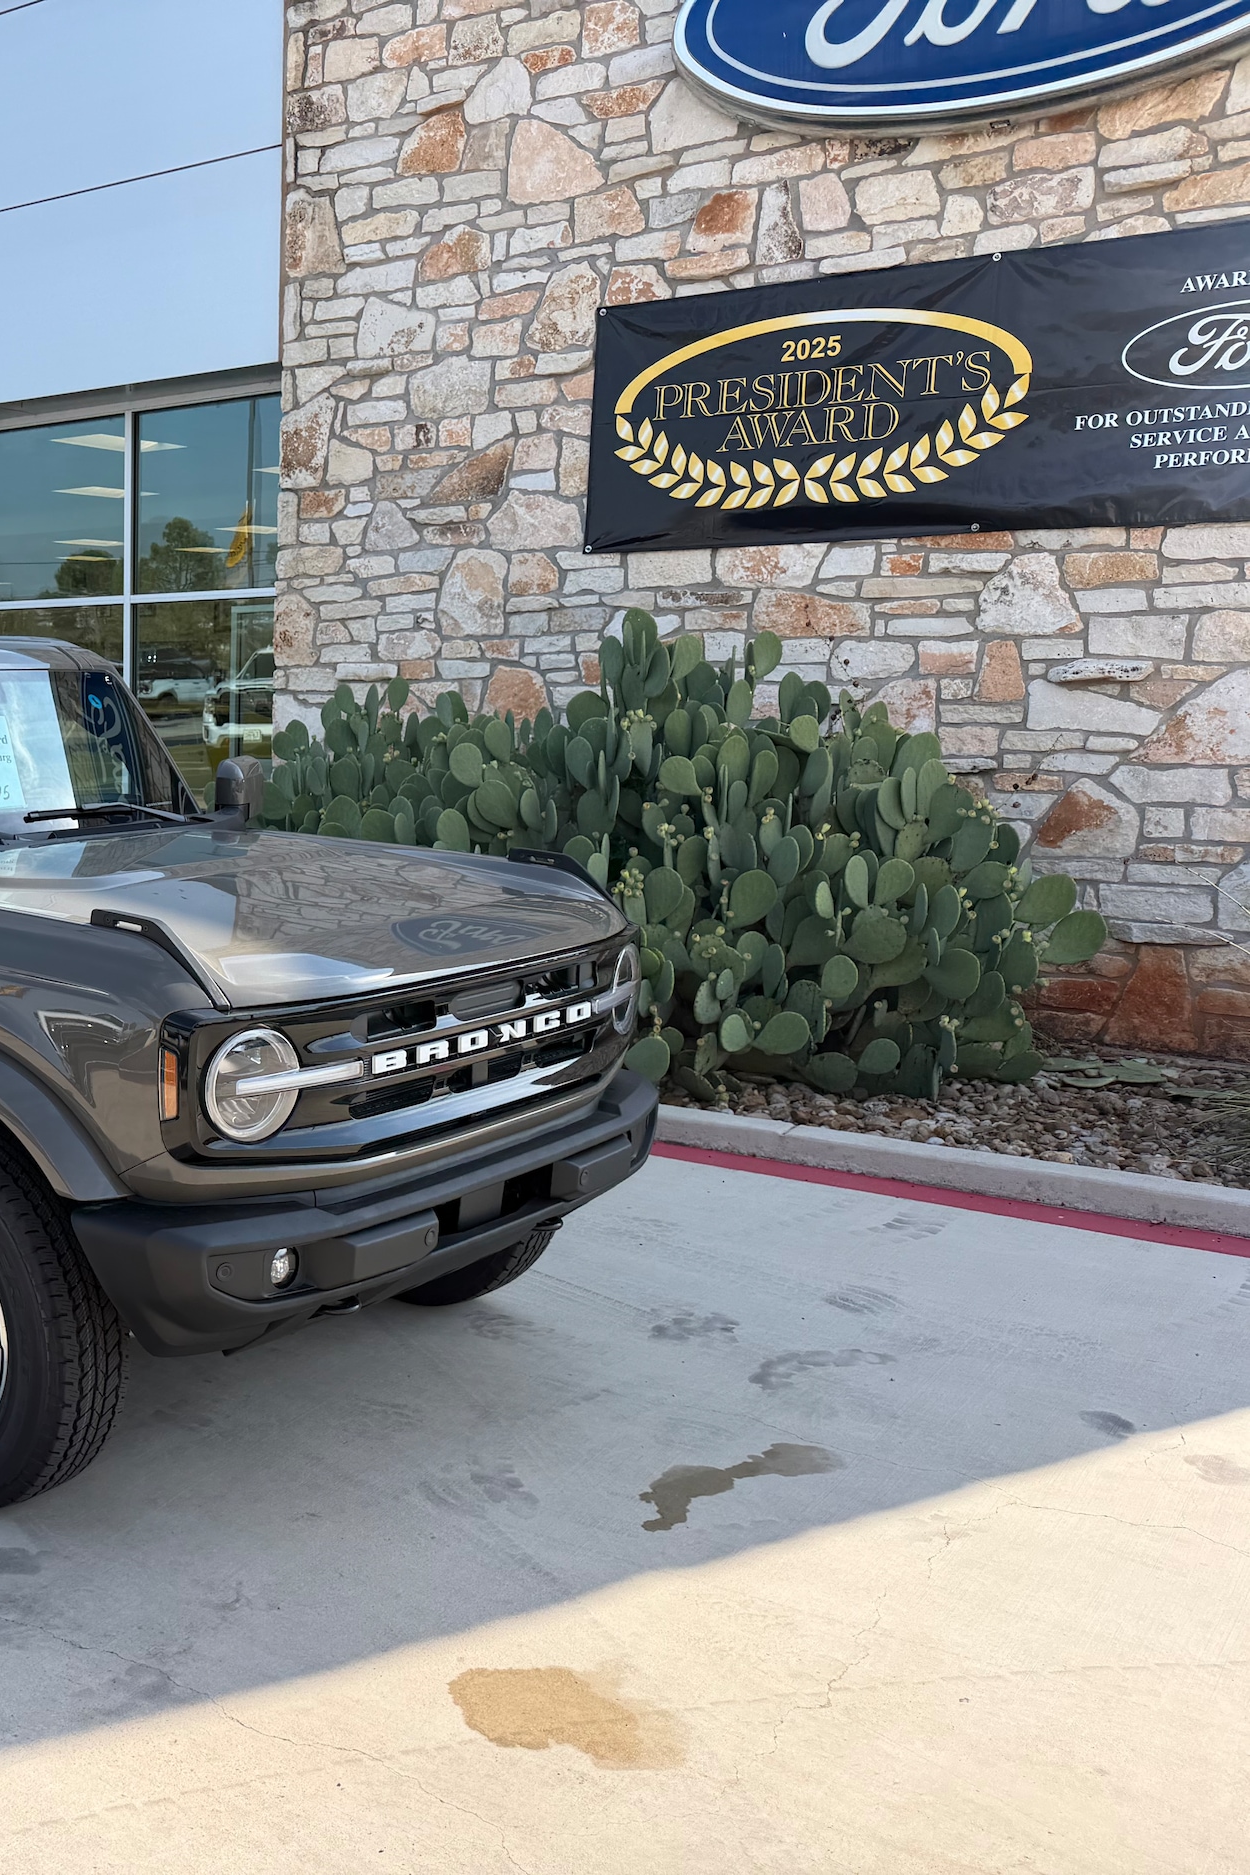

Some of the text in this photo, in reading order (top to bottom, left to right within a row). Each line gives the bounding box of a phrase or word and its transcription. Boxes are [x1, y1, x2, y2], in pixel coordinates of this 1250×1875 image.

[1180, 270, 1250, 294] AWAR
[781, 335, 842, 363] 2025
[653, 350, 992, 421] PRESIDENT'S
[716, 402, 899, 453] AWARD
[1074, 412, 1119, 431] FOR
[1129, 425, 1227, 449] SERVICE
[1153, 447, 1250, 470] PERFOR
[372, 1001, 592, 1075] BRONCO
